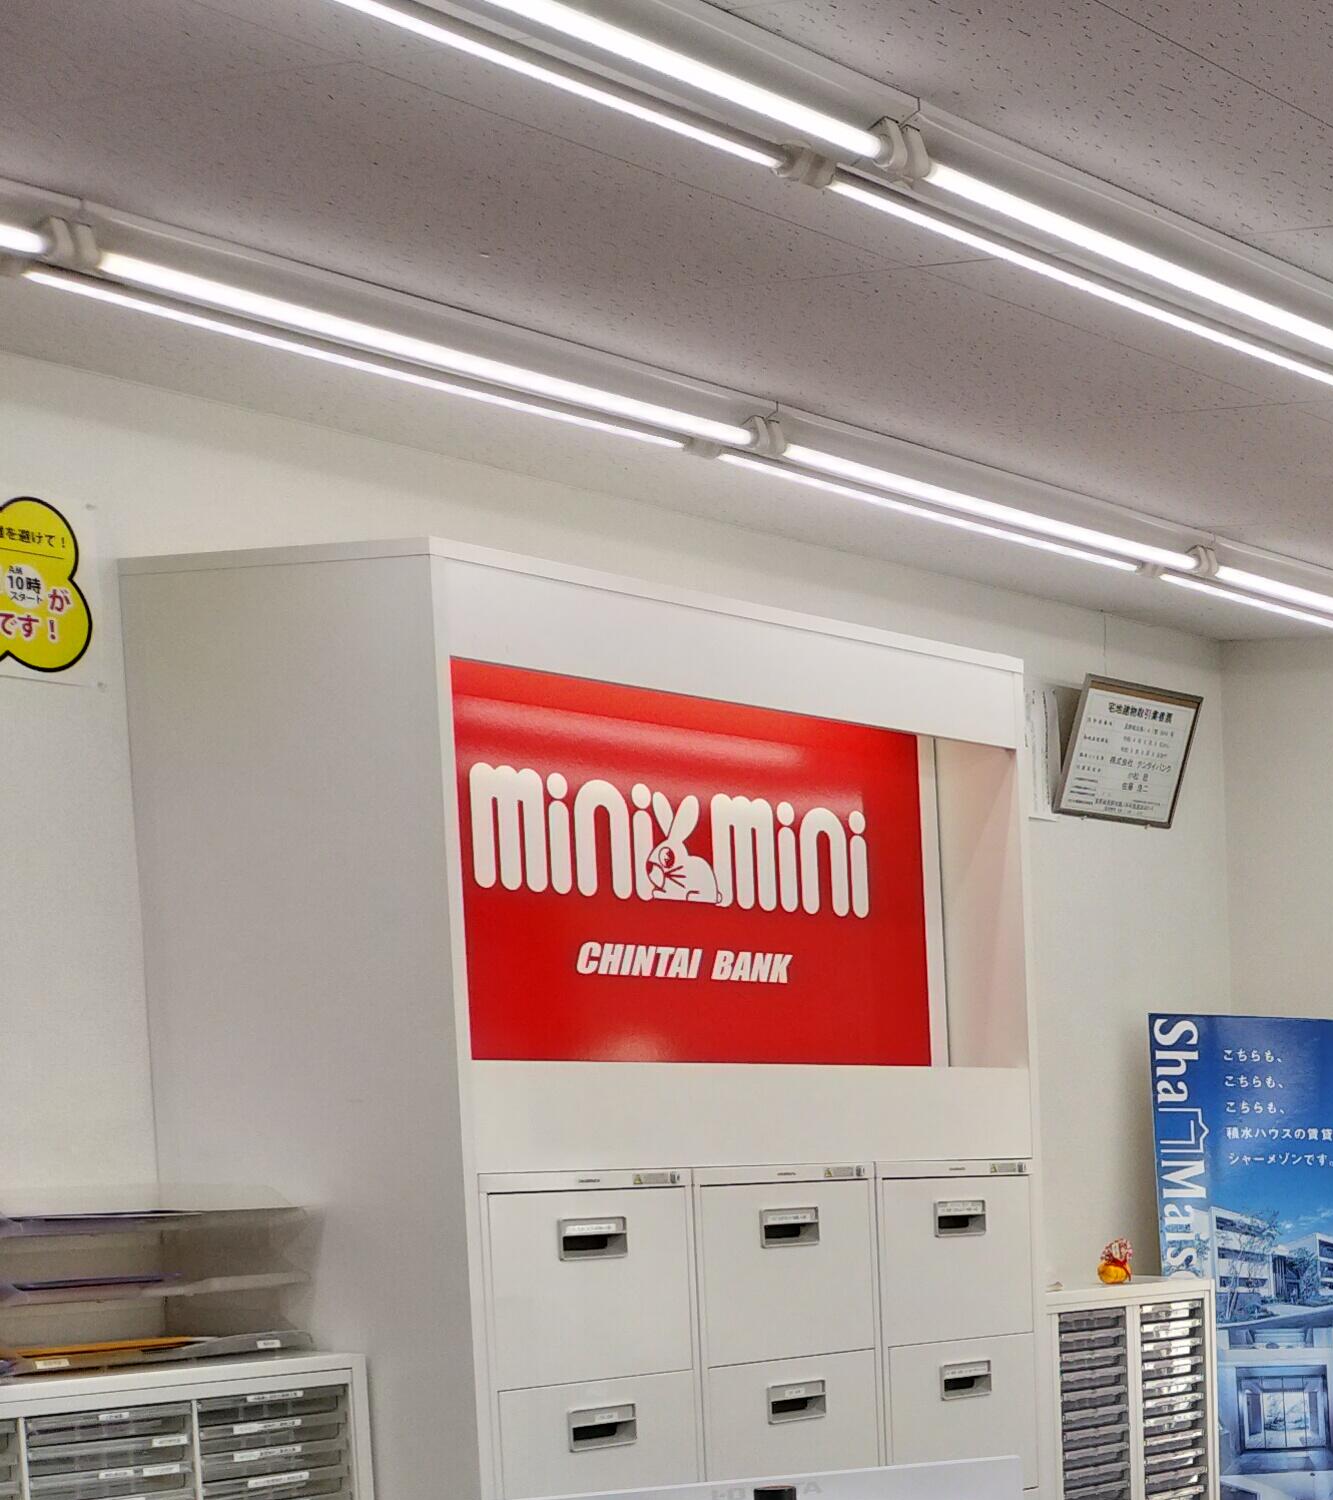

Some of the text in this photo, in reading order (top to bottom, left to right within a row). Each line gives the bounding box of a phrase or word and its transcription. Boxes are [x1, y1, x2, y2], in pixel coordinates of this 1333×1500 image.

[7, 575, 41, 594] 10時
[469, 761, 869, 918] mini mini
[576, 941, 792, 985] CHINTAI BANK
[1223, 1049, 1283, 1063] こちらも、
[1224, 1075, 1285, 1089] こちらも、
[1225, 1101, 1287, 1115] こちらも、
